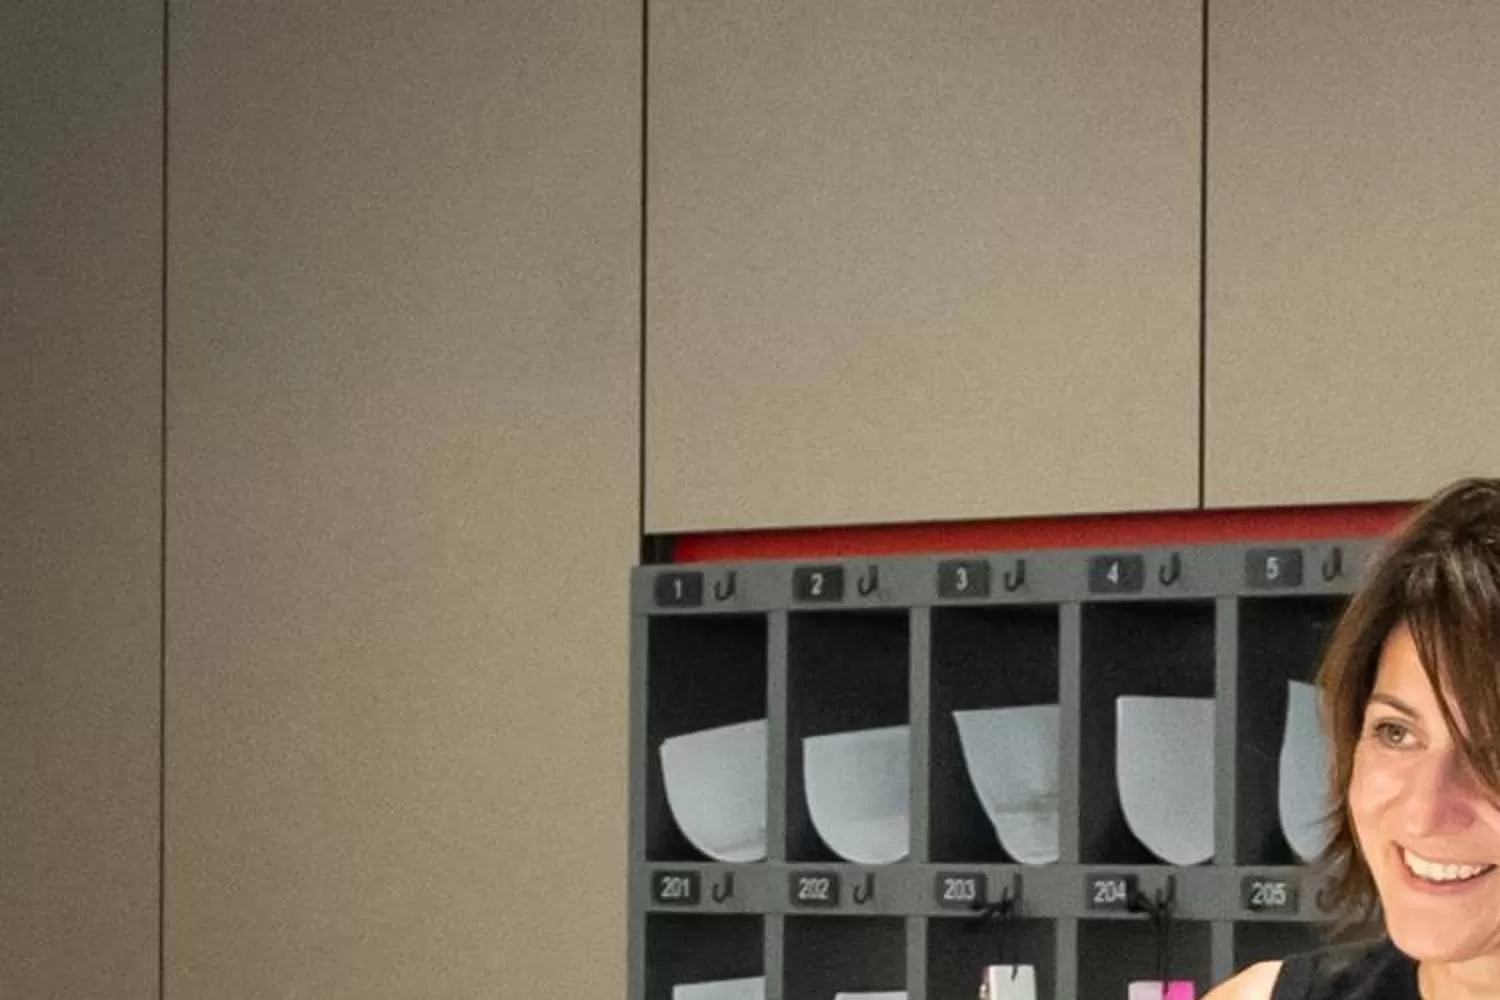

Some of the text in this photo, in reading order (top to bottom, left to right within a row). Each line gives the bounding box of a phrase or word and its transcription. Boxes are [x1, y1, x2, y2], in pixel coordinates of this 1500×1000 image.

[956, 567, 968, 590] 3
[1106, 562, 1118, 584] 4
[1266, 557, 1279, 580] 5
[675, 580, 682, 599] 1
[811, 573, 823, 595] 2
[661, 876, 689, 898] 201
[798, 877, 830, 900] 202
[943, 878, 976, 900] 203
[1093, 880, 1126, 903] 204
[1251, 882, 1287, 905] 205
